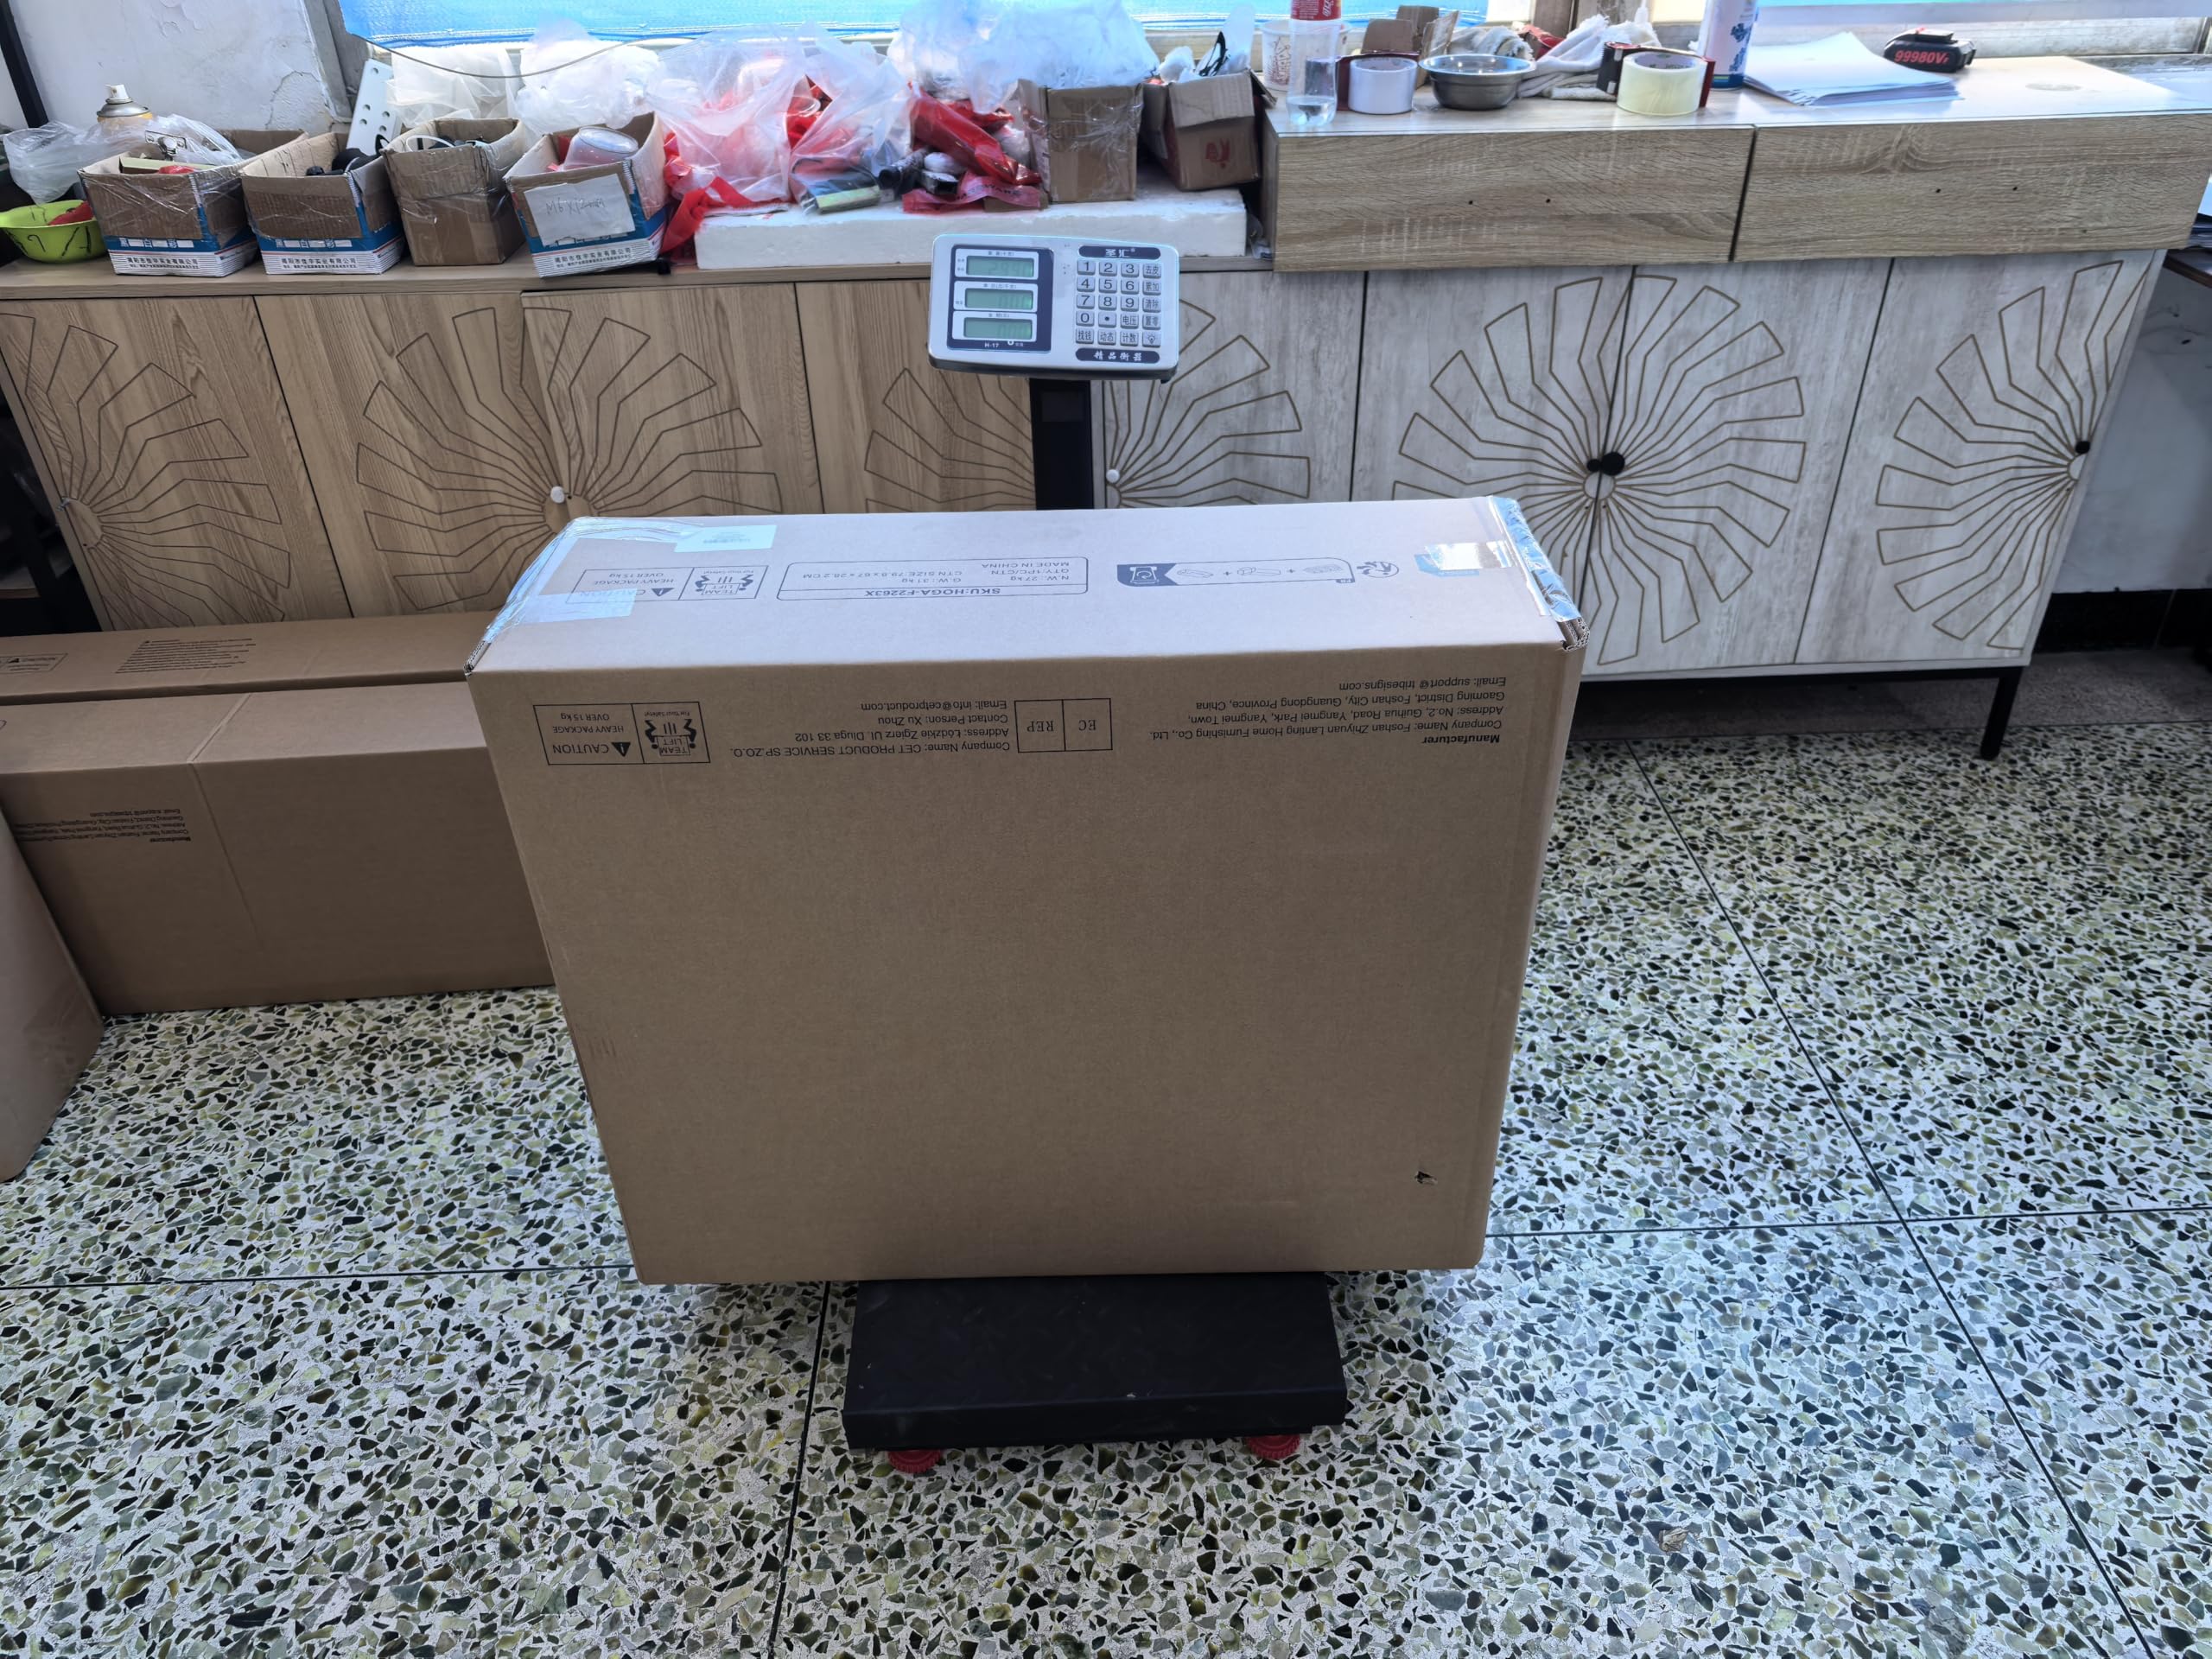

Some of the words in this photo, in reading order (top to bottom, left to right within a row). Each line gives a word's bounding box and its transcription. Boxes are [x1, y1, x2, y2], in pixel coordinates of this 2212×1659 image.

[1084, 262, 1090, 272] 1
[1104, 263, 1114, 273] 2
[1126, 264, 1135, 274] 3
[1081, 278, 1090, 289] 4
[1103, 279, 1113, 289] 5
[1125, 280, 1135, 290] 6
[1081, 295, 1090, 305] 7
[1103, 296, 1112, 307] 8
[1125, 298, 1135, 308] 9
[1080, 312, 1090, 323] 0
[1122, 315, 1137, 326] 电压
[1122, 333, 1136, 342] 计数
[1338, 679, 1415, 691] tribesigns.com
[1419, 677, 1471, 690] support@
[1472, 677, 1507, 687] Email:
[1344, 695, 1369, 707] City,
[1371, 695, 1411, 705] Foshan
[1414, 693, 1453, 704] District,
[1457, 690, 1505, 702] Gaoming
[861, 700, 972, 712] info@cetproduct.com
[974, 700, 1007, 709] Email:
[1195, 701, 1226, 711] China
[1229, 699, 1277, 709] Province,
[1281, 696, 1342, 708] Guangdong
[1300, 710, 1347, 721] Yangmei
[1351, 709, 1381, 721] Road,
[1384, 709, 1422, 719] Guihua
[1426, 707, 1453, 717] No.2,
[1457, 705, 1504, 715] Address:
[877, 716, 905, 727] Zhou
[907, 716, 922, 726] Xu
[925, 715, 965, 725] Person:
[968, 714, 1008, 724] Contact
[1187, 715, 1217, 725] Town,
[1221, 712, 1268, 724] Yangmei
[1271, 712, 1297, 722] Park,
[552, 725, 594, 734] PACKAGE
[1027, 720, 1054, 733] REP
[1077, 719, 1096, 731] EC
[1287, 724, 1325, 735] Lanting
[1327, 723, 1370, 734] Zhiyuan
[1371, 722, 1411, 733] Foshan
[1414, 721, 1449, 731] Name:
[1452, 719, 1502, 730] Company
[794, 733, 813, 742] 102
[817, 732, 831, 741] 33
[834, 729, 865, 741] Dluga
[886, 728, 918, 740] Zgierz
[963, 728, 1009, 738] Address:
[1148, 731, 1169, 741] Ltd.
[1172, 729, 1193, 740] Co.,
[1196, 728, 1249, 739] Furnishing
[1252, 727, 1283, 737] Home
[1421, 734, 1500, 745] Manufacturer
[552, 743, 609, 753] CAUTION
[785, 746, 835, 756] SERVICE
[838, 745, 895, 755] PRODUCT
[899, 744, 921, 753] CET
[925, 743, 959, 753] Name:
[961, 741, 1010, 752] Company
